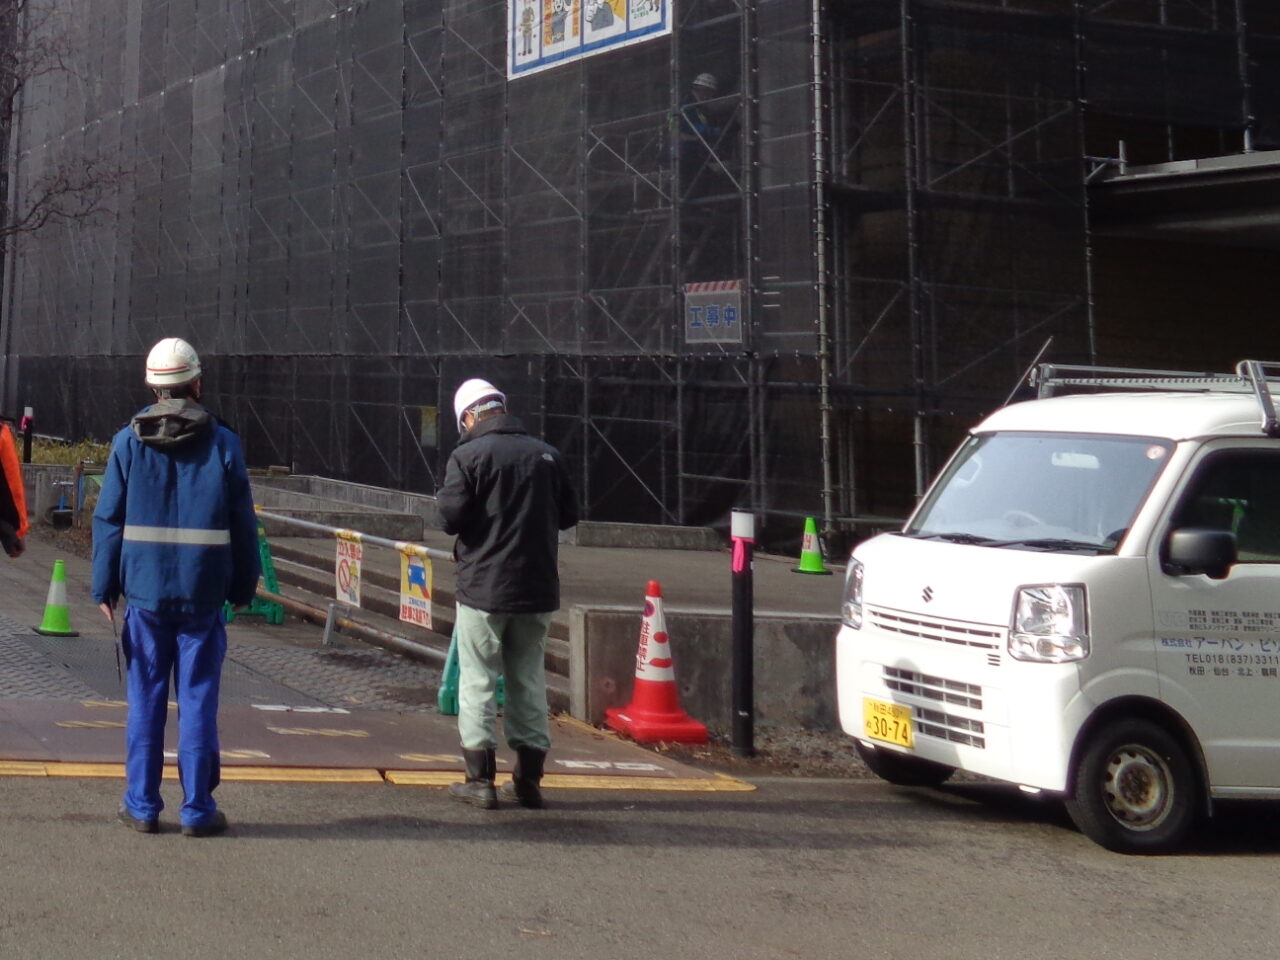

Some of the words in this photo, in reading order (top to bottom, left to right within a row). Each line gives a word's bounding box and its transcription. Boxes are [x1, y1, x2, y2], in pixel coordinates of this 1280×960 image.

[689, 304, 738, 328] 工事中
[873, 716, 908, 743] 30-74
